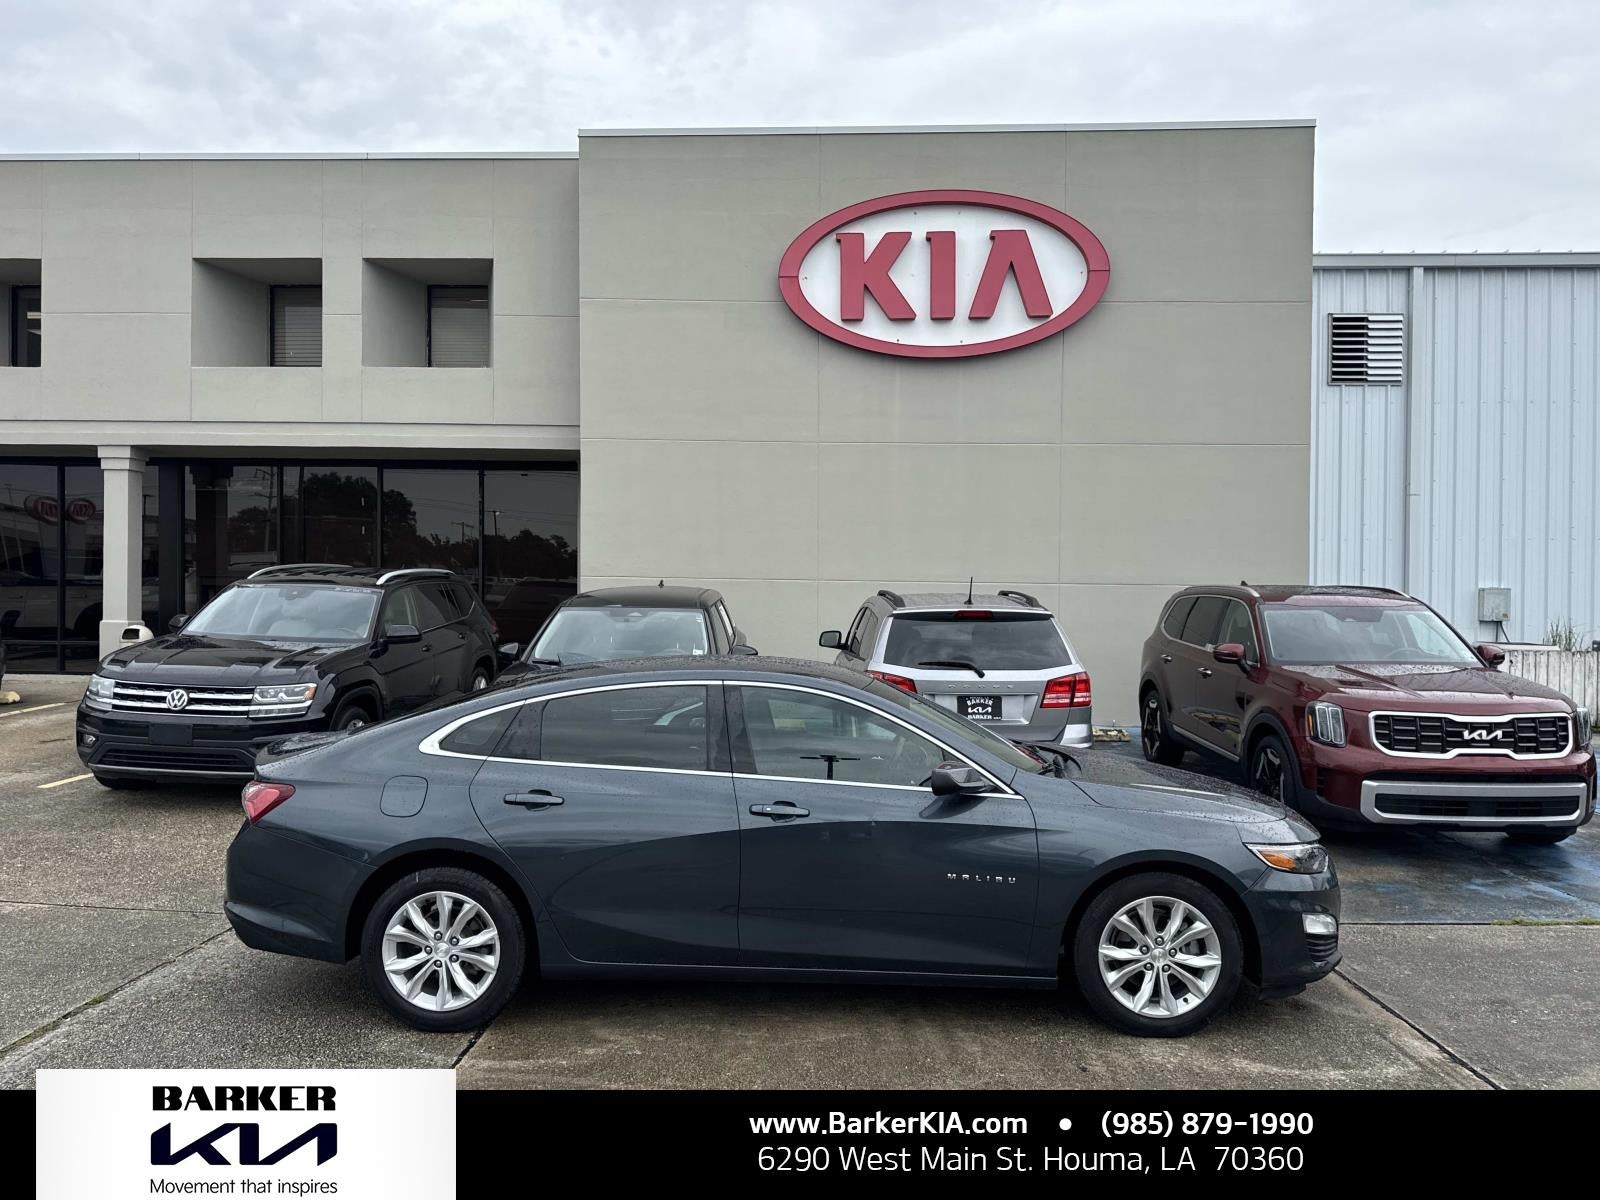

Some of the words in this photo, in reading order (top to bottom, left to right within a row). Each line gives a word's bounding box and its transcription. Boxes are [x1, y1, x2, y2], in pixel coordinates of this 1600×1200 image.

[835, 229, 1054, 322] KIA
[1463, 729, 1503, 740] KIA
[947, 873, 1016, 884] MALIBU
